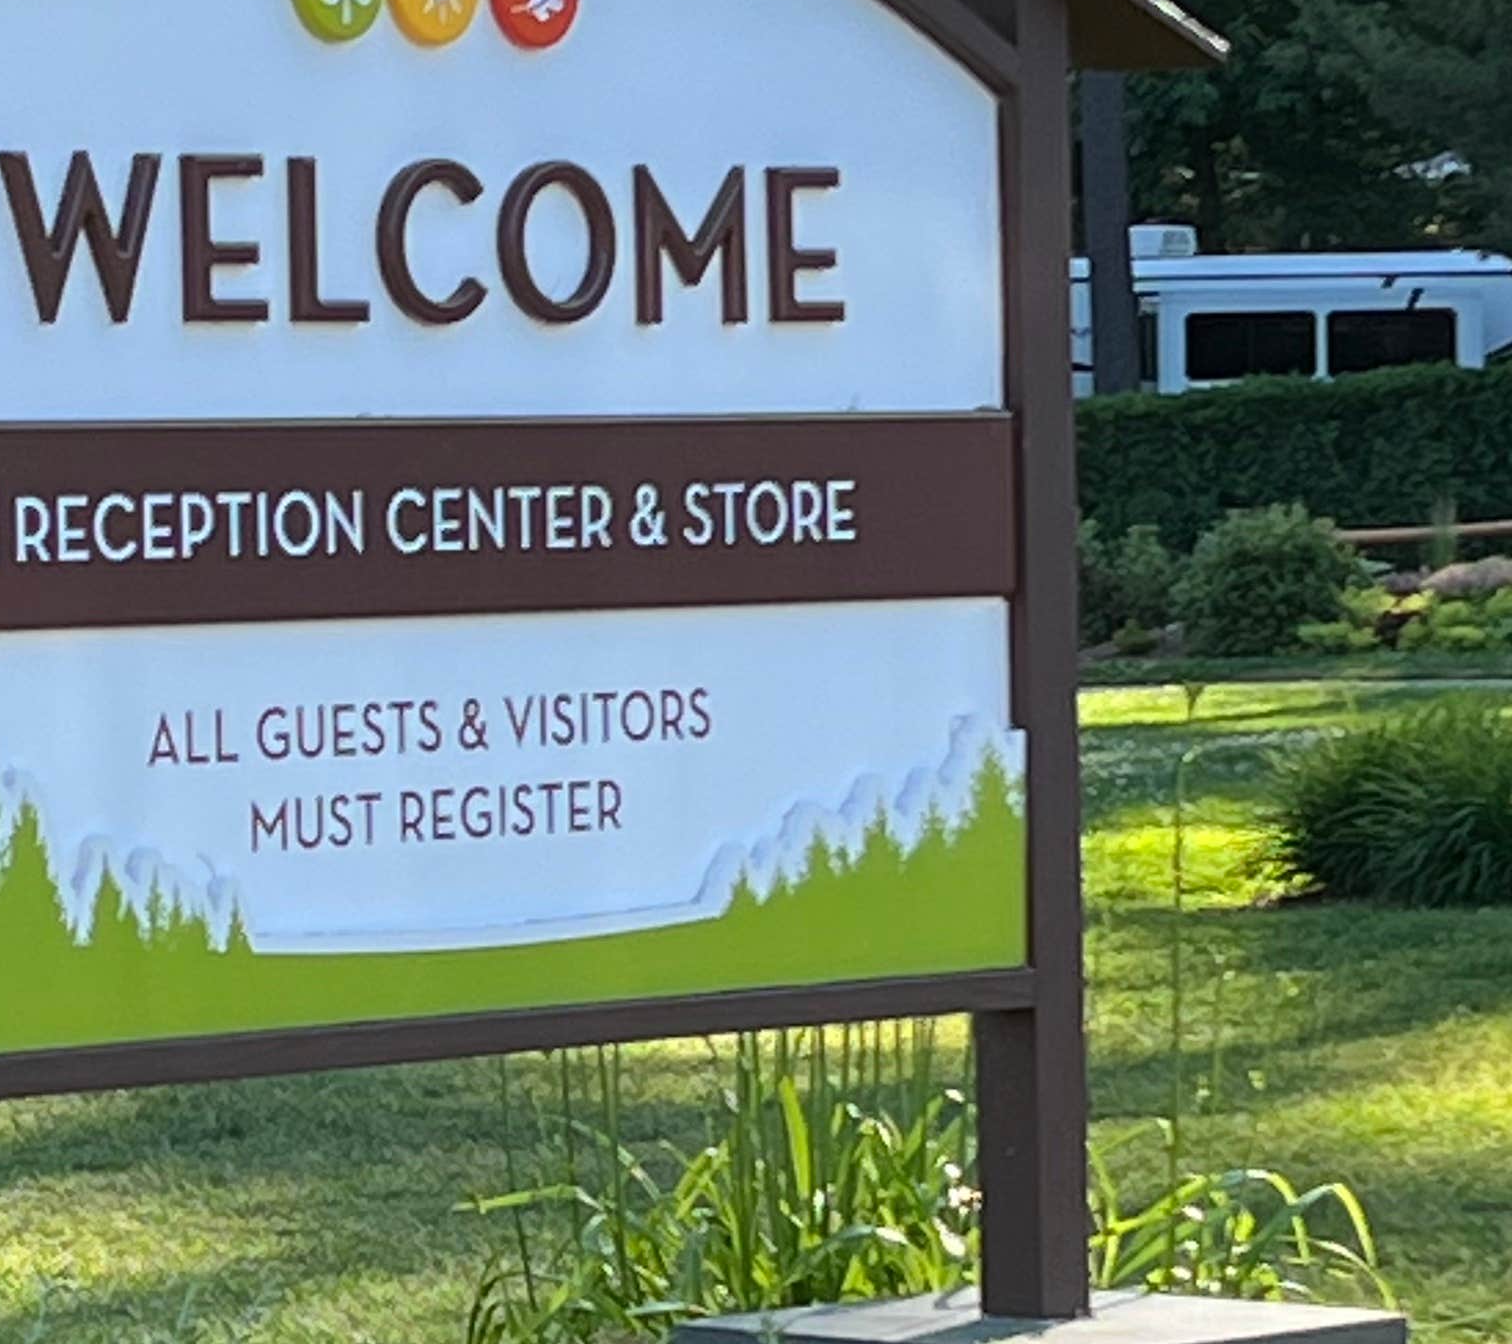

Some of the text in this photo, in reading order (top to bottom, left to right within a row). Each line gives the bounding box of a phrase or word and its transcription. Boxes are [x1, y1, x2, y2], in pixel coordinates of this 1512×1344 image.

[14, 480, 856, 563] RECEPTION CENTER & STORE
[147, 688, 712, 766] ALL GUESTS & VISITORS
[250, 780, 622, 853] MUST REGISTER
